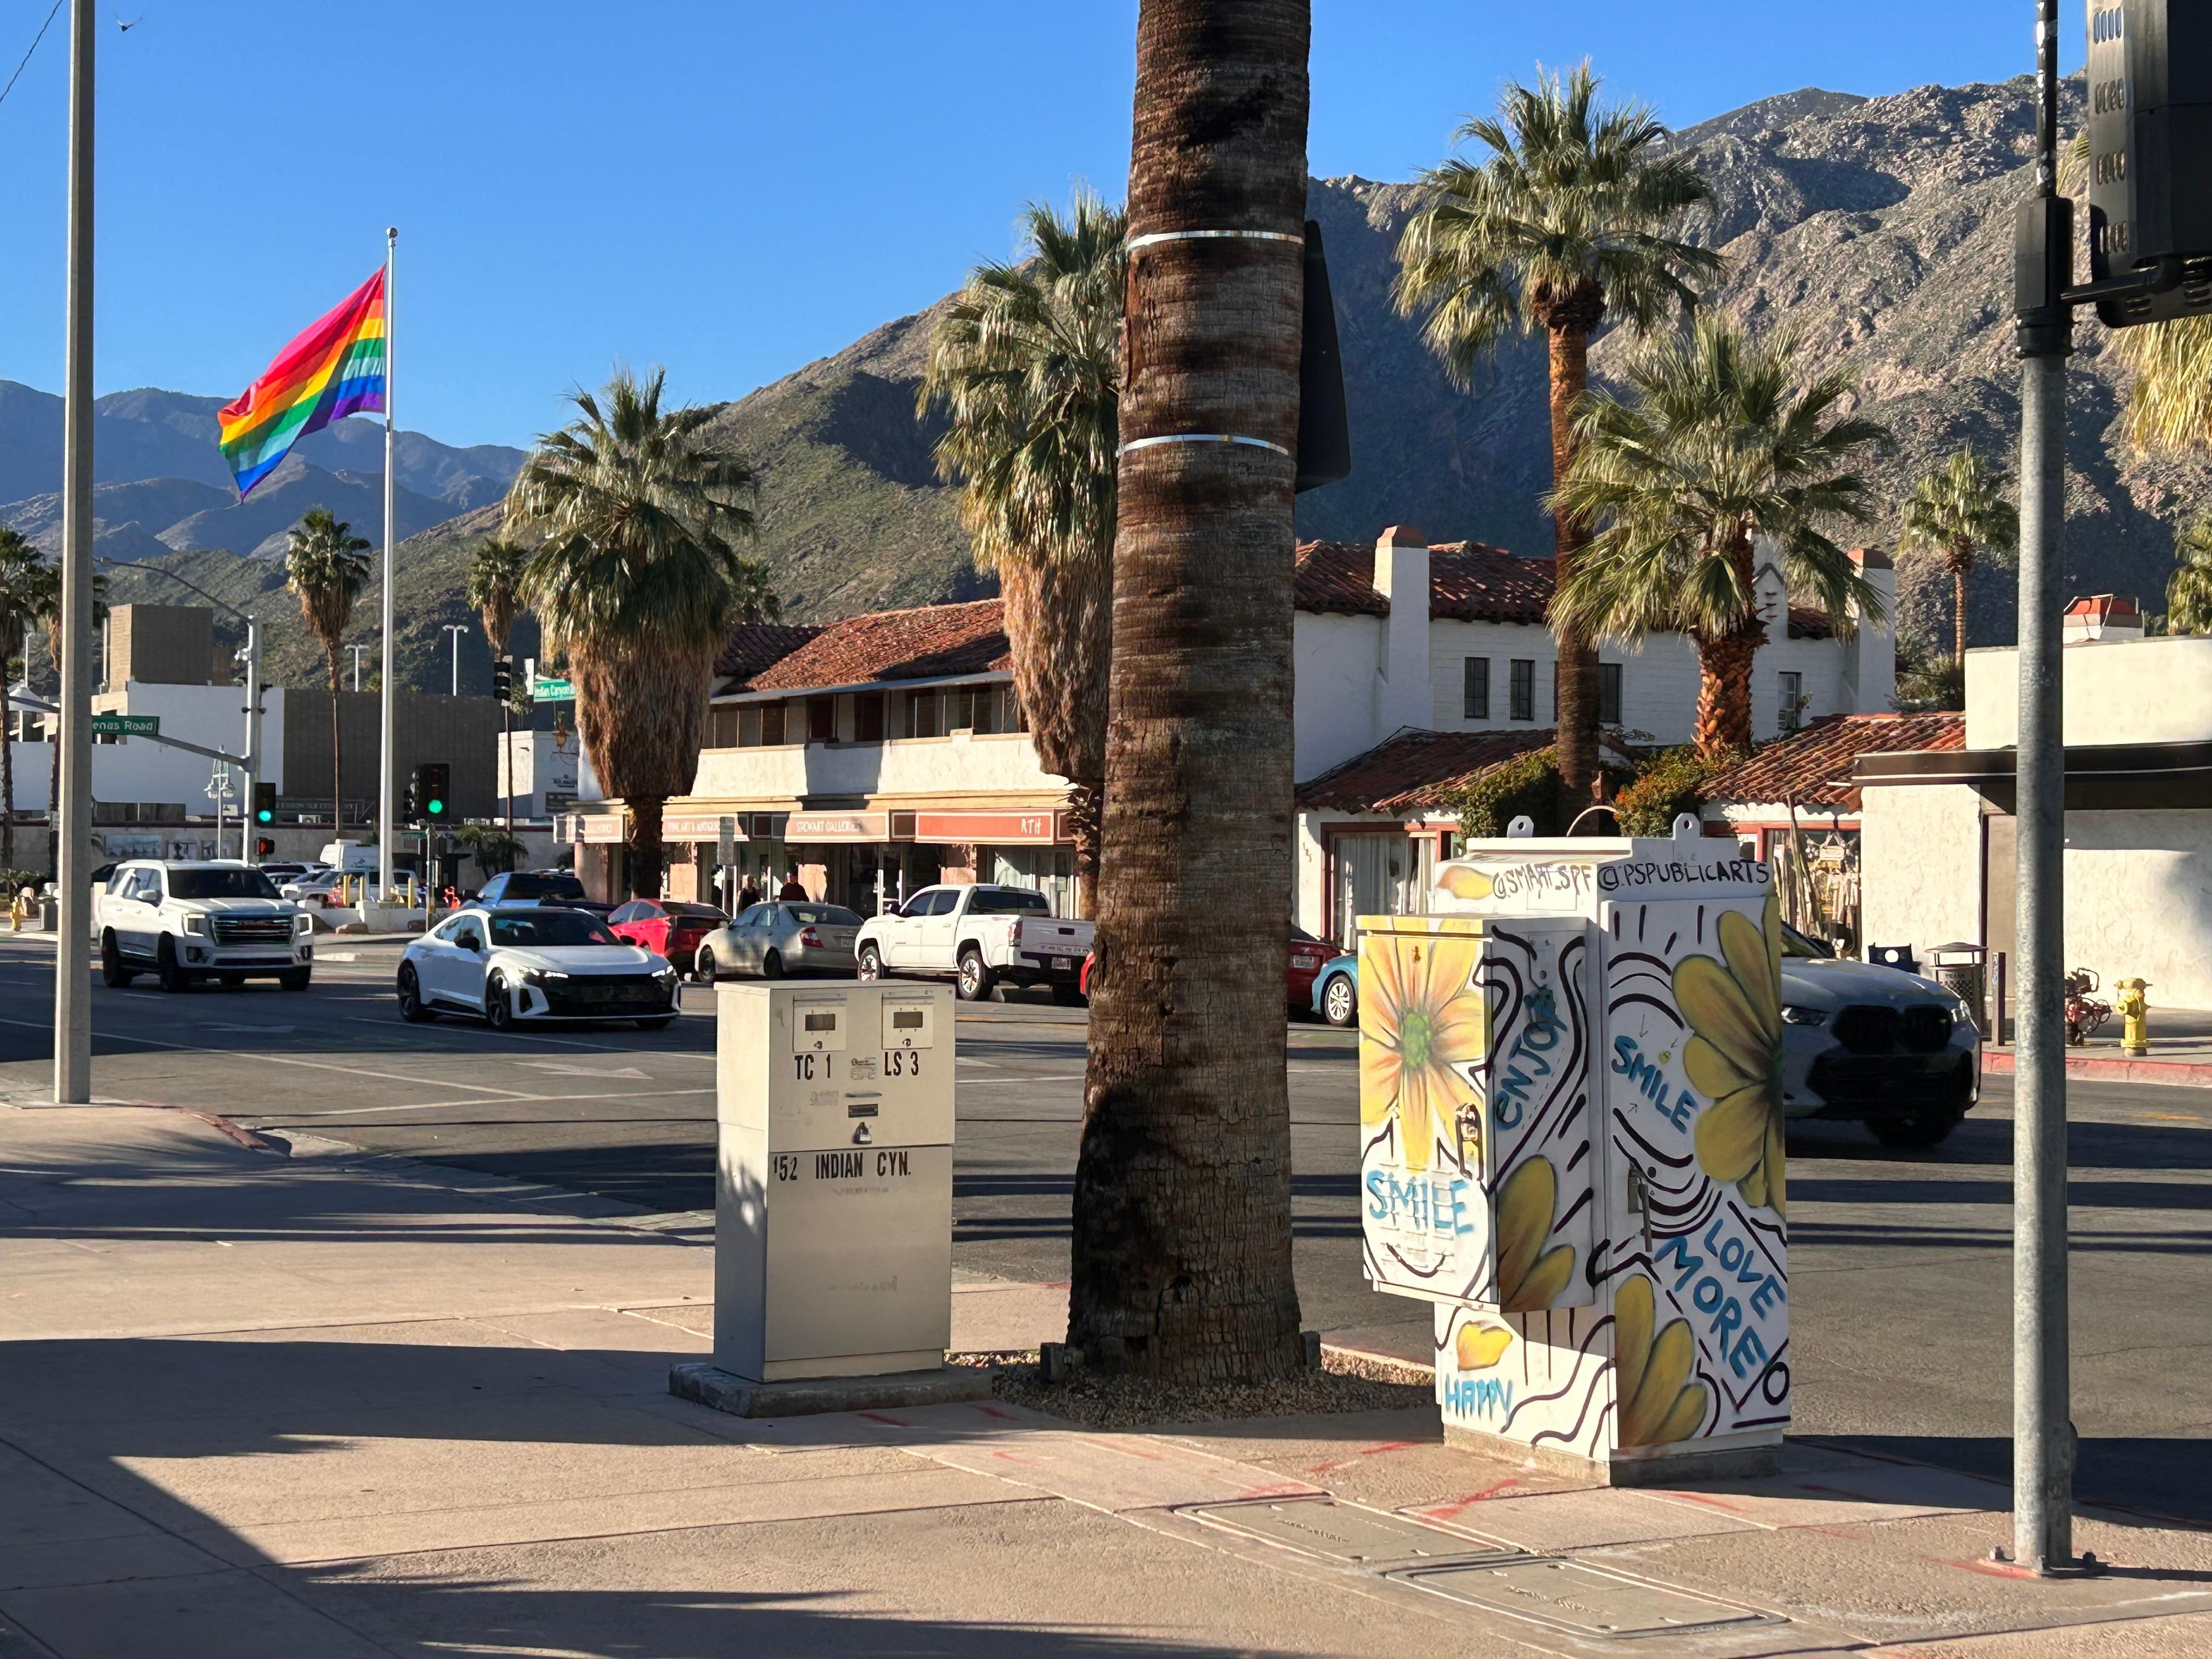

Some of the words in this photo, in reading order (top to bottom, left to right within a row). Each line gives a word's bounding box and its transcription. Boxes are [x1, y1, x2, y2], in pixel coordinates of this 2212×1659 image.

[124, 720, 153, 730] Road
[1021, 817, 1041, 834] RTH
[794, 1054, 814, 1080] TC
[826, 1054, 831, 1079] 1
[884, 1051, 901, 1076] LS
[911, 1051, 919, 1076] 3
[1611, 1035, 1699, 1134] SMILE
[816, 1153, 863, 1179] INDIAN
[877, 1152, 911, 1176] CYN.
[1367, 1170, 1475, 1235] SMILE
[1703, 1218, 1786, 1321] LOVE
[1655, 1237, 1769, 1379] MORE
